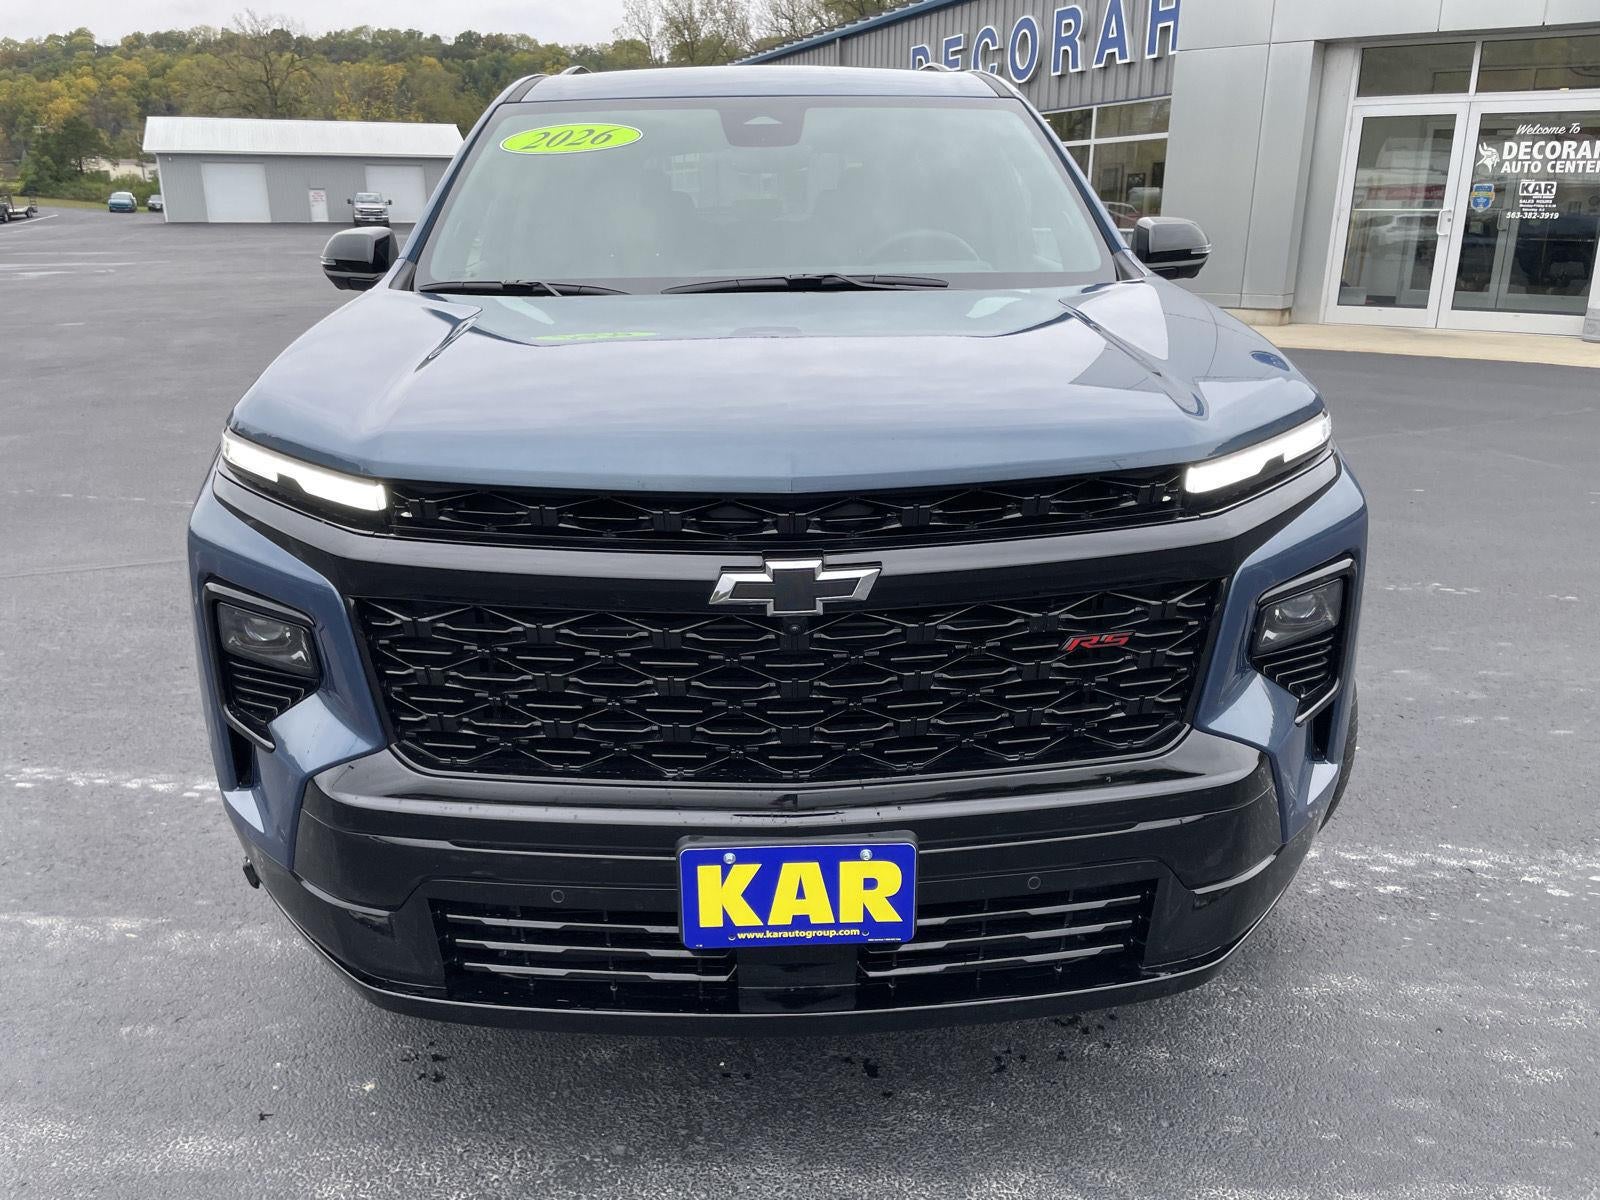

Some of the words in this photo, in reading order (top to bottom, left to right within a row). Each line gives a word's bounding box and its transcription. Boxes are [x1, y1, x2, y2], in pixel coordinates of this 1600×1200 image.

[1515, 123, 1566, 135] Welcome
[1568, 122, 1581, 134] To
[521, 128, 621, 150] 2026
[1500, 160, 1542, 173] AUTO
[1520, 183, 1555, 195] KAR
[1505, 211, 1560, 220] 563-382-3919
[1060, 631, 1135, 652] RS
[697, 860, 904, 928] KAR
[737, 928, 861, 940] www.karautogroup.com
